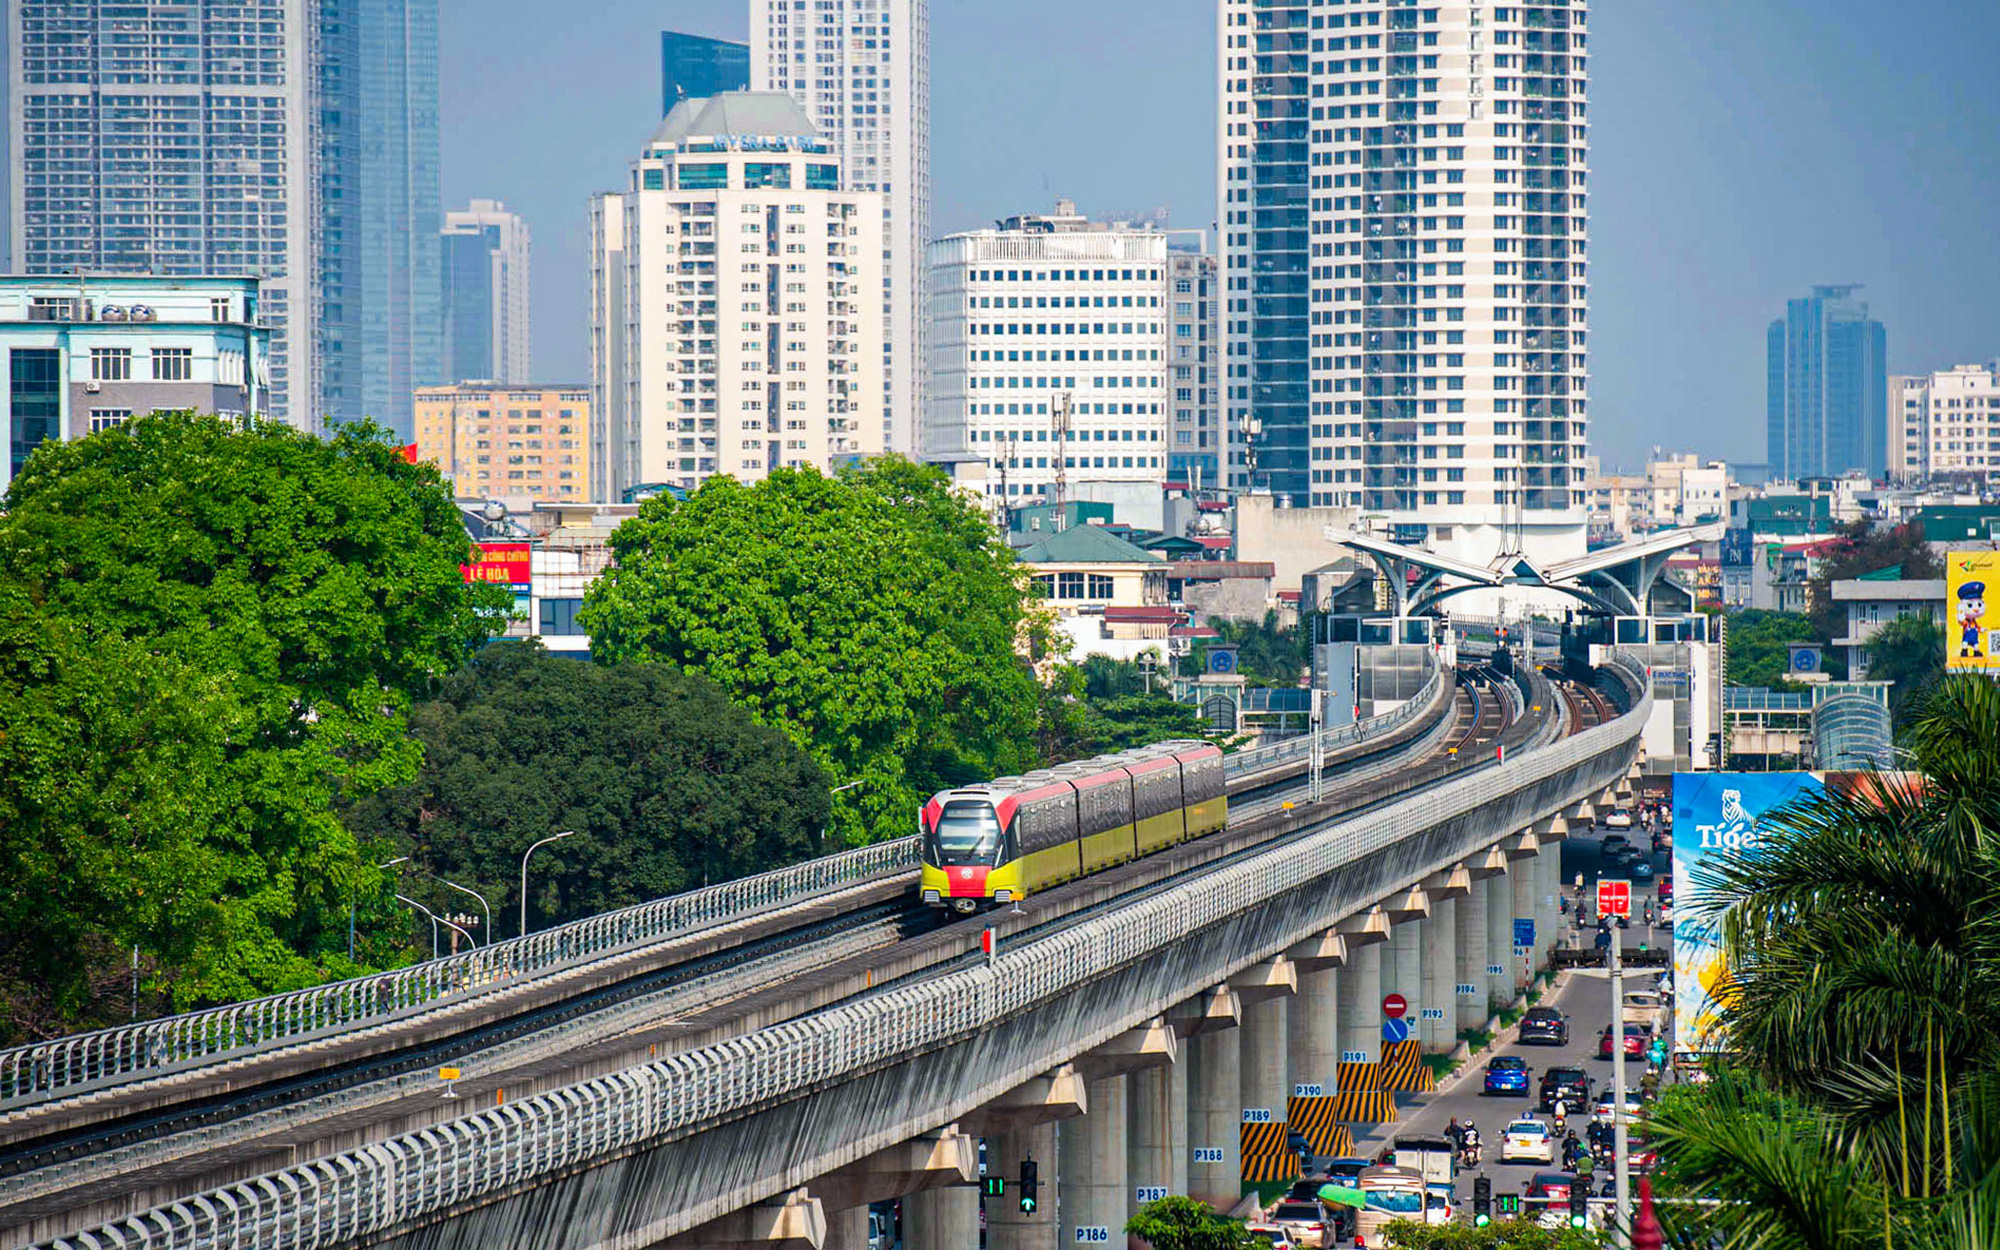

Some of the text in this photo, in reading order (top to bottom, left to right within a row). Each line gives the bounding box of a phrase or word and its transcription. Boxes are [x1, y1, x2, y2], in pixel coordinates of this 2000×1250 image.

[1422, 1009, 1443, 1018] P193
[1343, 1052, 1367, 1062] P191
[1296, 1085, 1321, 1096] P190
[1243, 1110, 1270, 1121] P189
[1194, 1149, 1223, 1161] P188
[1137, 1188, 1167, 1200] P187
[1076, 1228, 1108, 1241] P186
